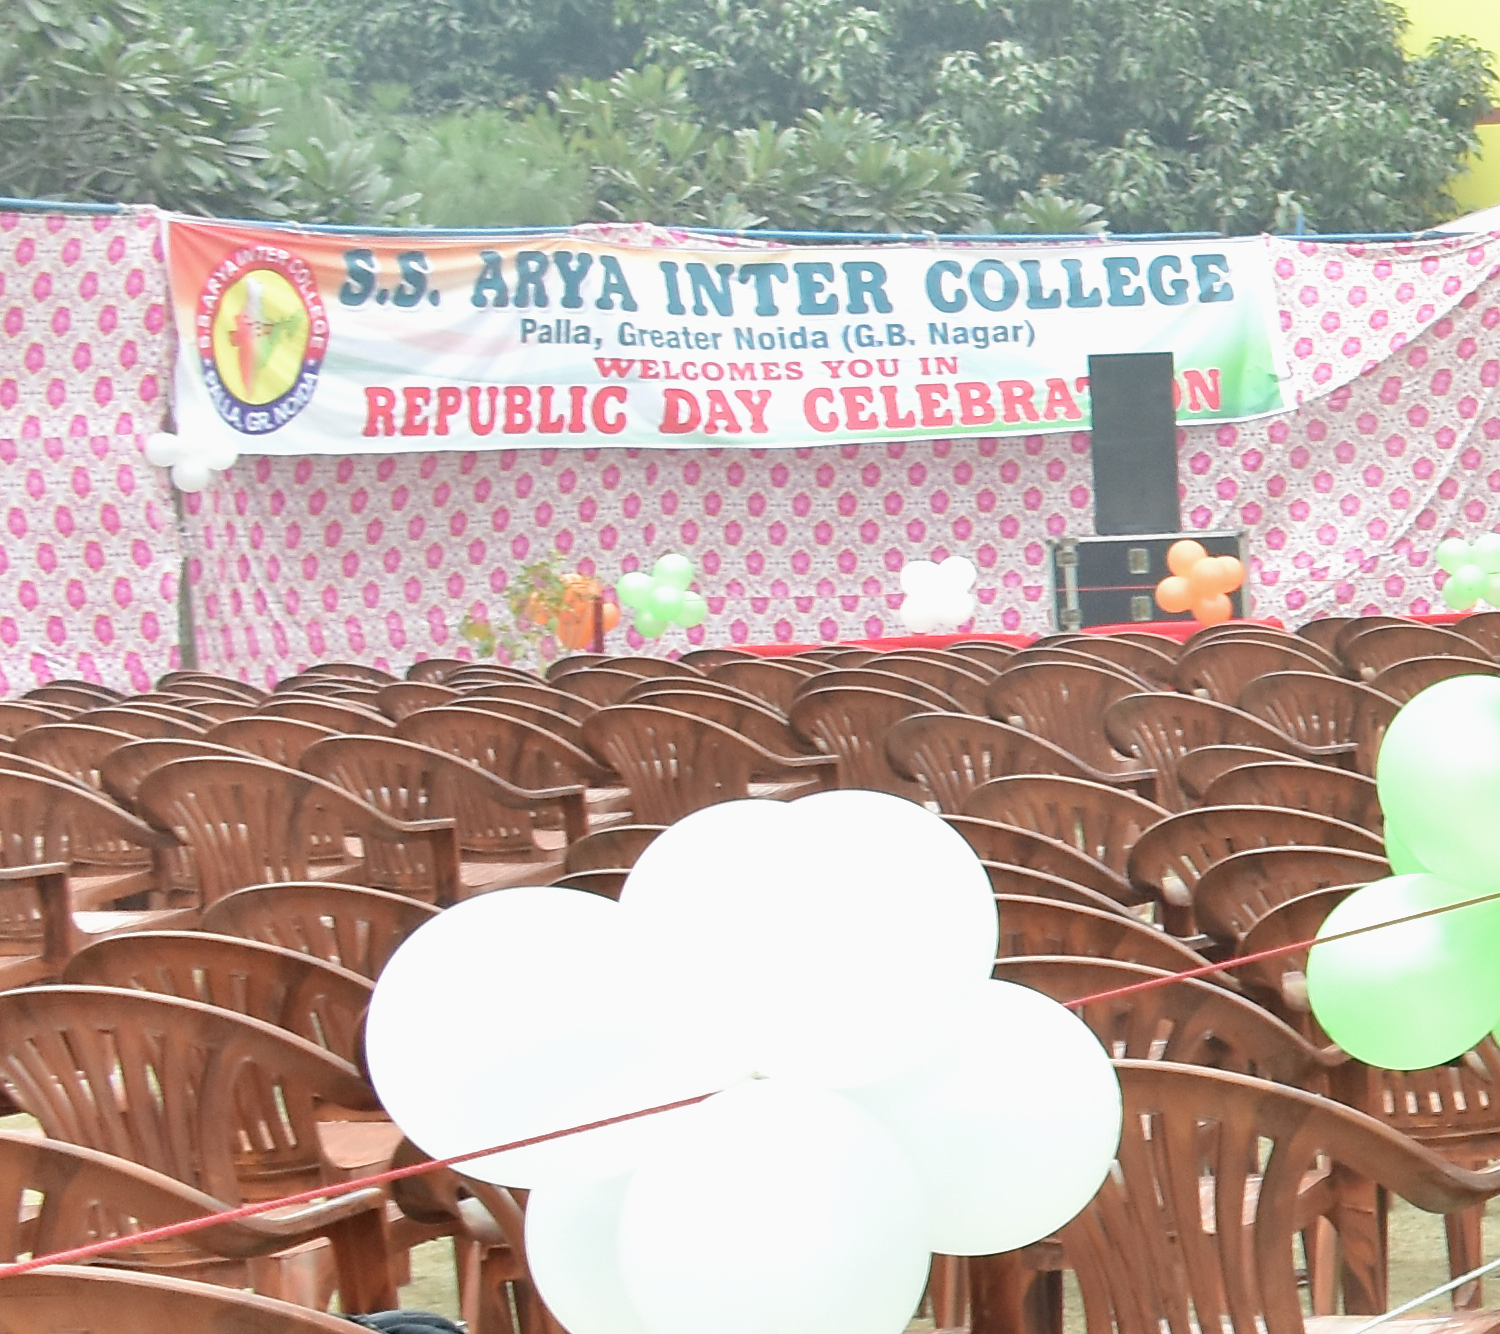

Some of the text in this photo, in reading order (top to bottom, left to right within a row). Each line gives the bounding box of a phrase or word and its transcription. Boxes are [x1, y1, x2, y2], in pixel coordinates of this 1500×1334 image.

[338, 248, 1235, 317] S.S. ARYA INTER COLLEGE
[520, 318, 1036, 352] Palla, Greater Noida (G.B. Nagar)
[594, 356, 959, 382] WELCOMES YOU IN
[362, 368, 1222, 438] REPUBLIC DAY CELEBRAN
